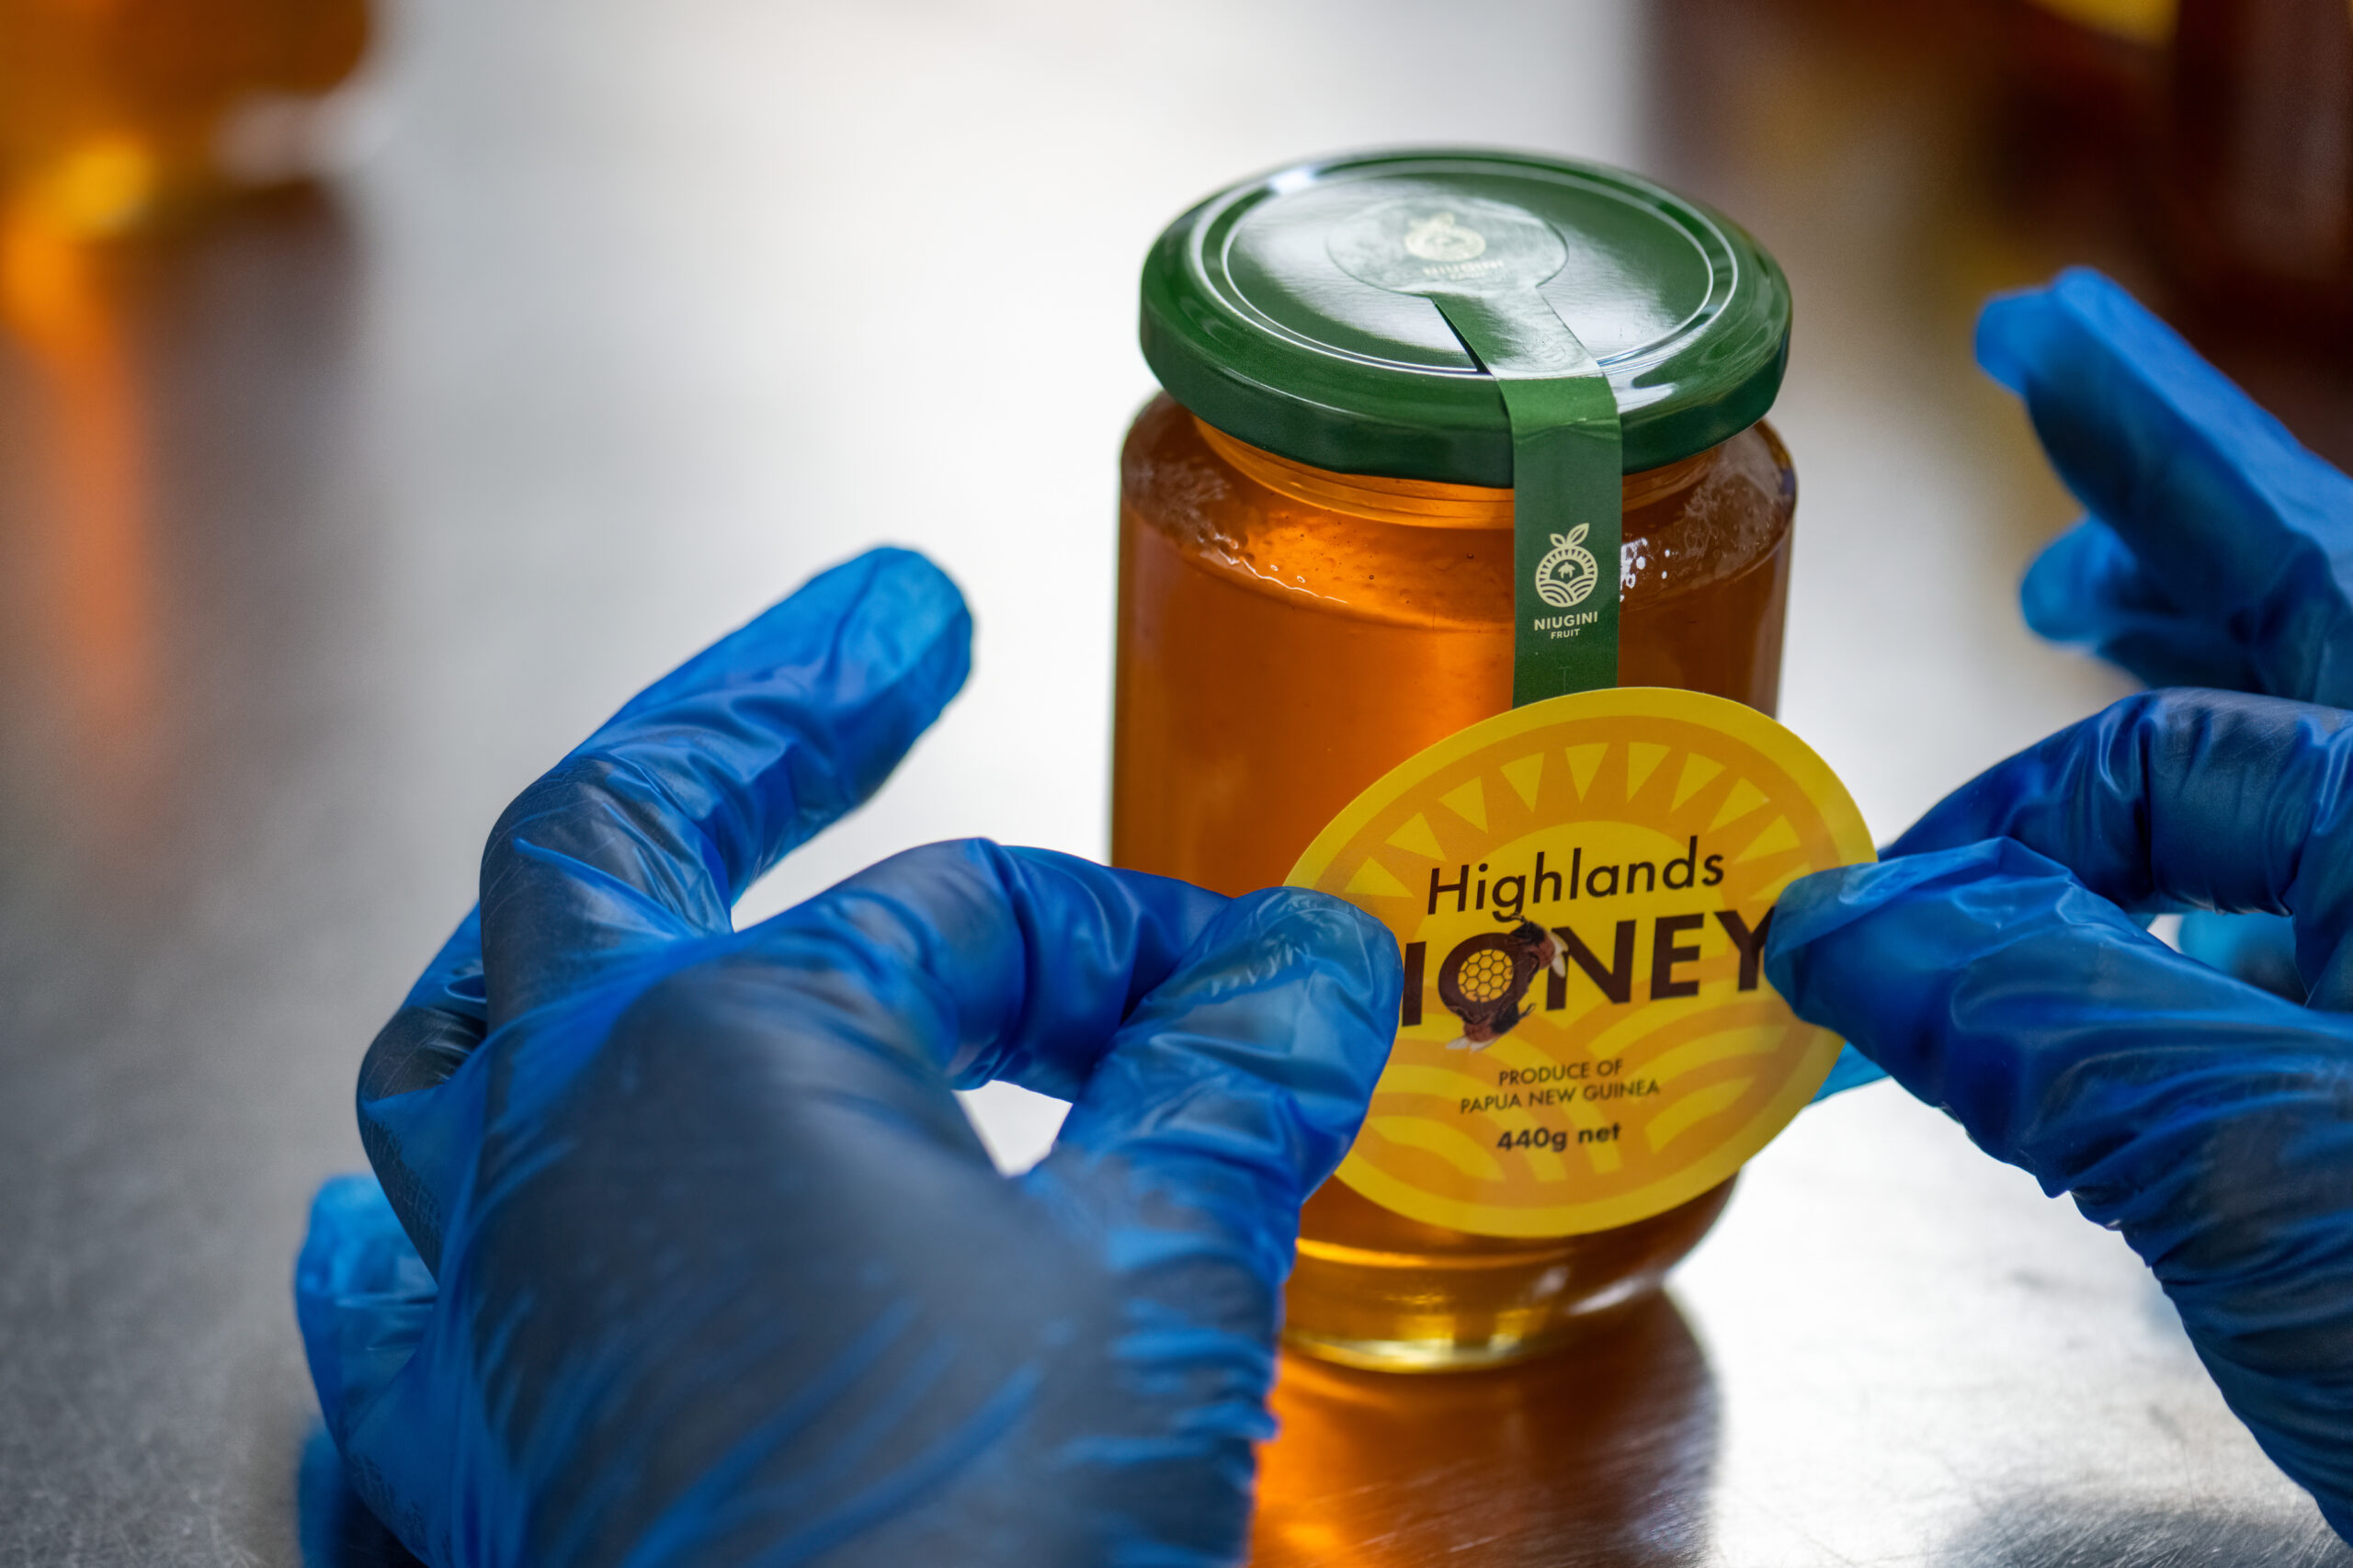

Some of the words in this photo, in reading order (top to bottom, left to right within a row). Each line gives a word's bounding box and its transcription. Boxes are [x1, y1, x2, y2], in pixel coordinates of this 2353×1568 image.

[1534, 611, 1598, 631] NIUGINI
[1551, 629, 1580, 640] FRUIT
[1427, 835, 1724, 923] Highlands
[1498, 1062, 1589, 1086] PRODUCE
[1597, 1059, 1623, 1077] OF
[1460, 1093, 1522, 1114] PAPUA
[1529, 1087, 1576, 1107] NEW
[1583, 1079, 1661, 1101] GUINEA
[1496, 1127, 1567, 1153] 440g
[1578, 1122, 1620, 1143] net
